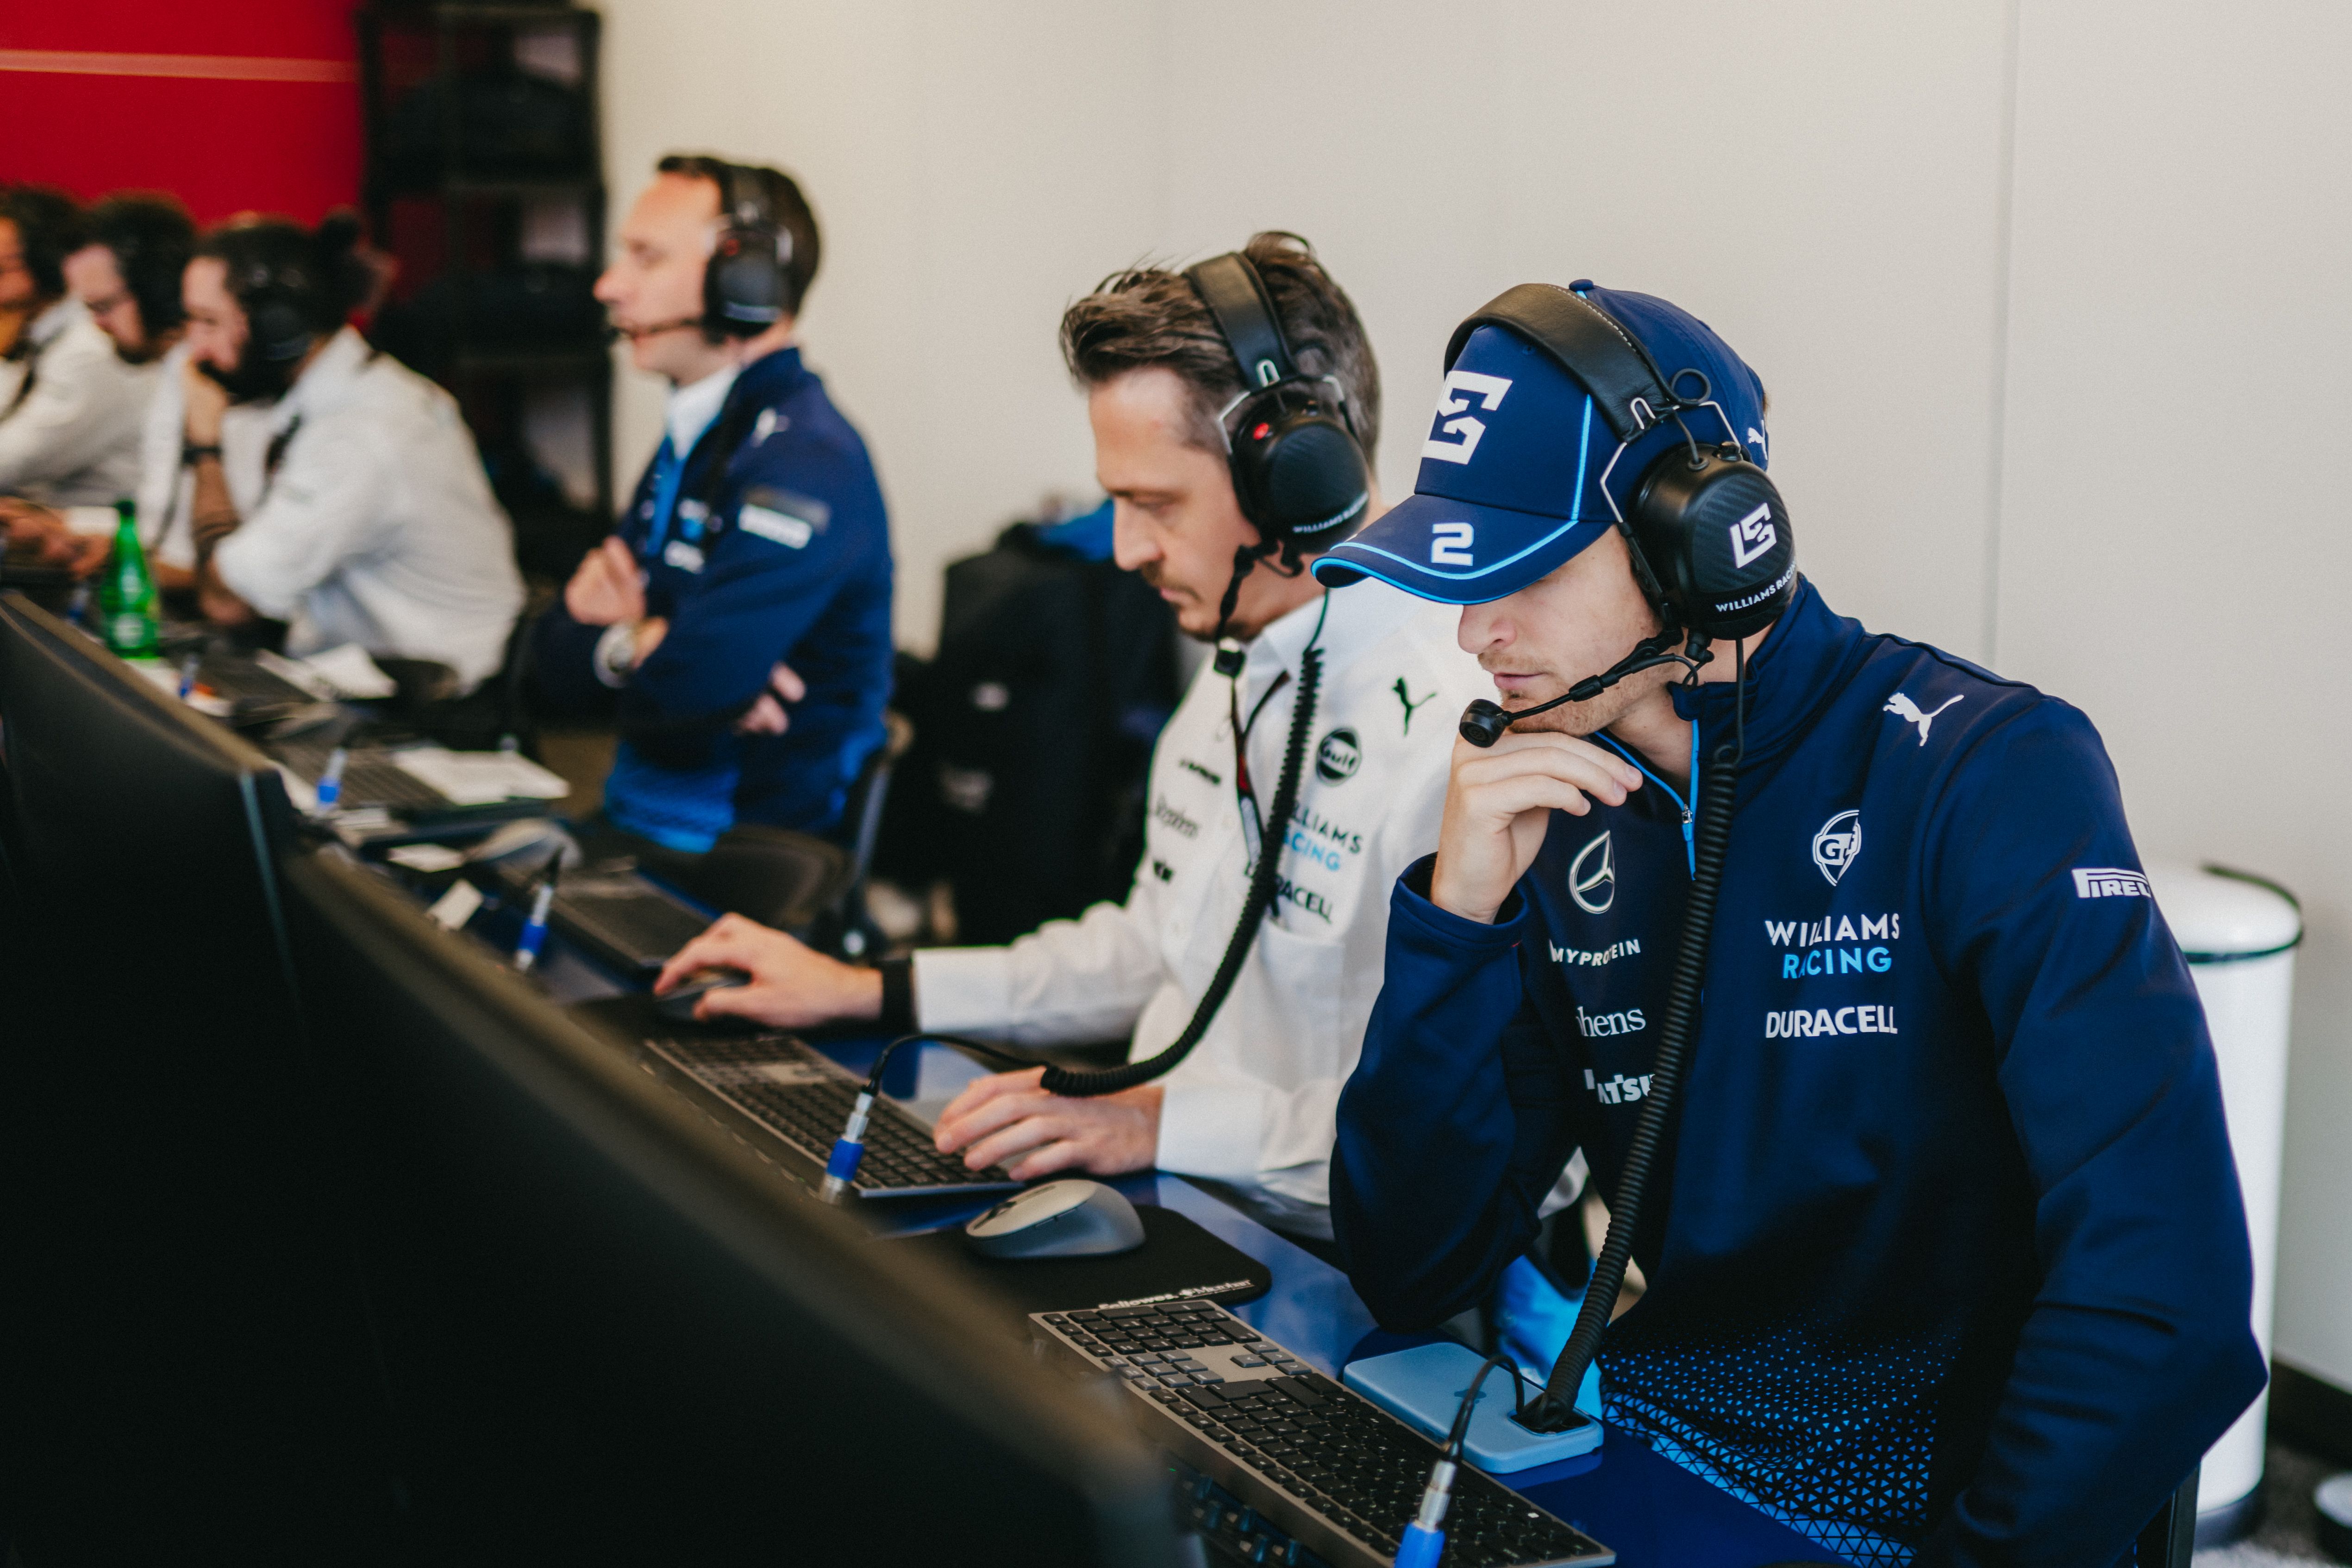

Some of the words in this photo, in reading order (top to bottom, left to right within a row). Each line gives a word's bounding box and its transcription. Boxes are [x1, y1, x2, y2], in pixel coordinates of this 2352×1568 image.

[1431, 522, 1475, 567] 2
[1715, 584, 1776, 612] WILLIAMS
[1776, 561, 1796, 590] RACIN
[2071, 868, 2152, 899] PIREL
[1764, 913, 1900, 948] WILLIAMS
[1576, 1006, 1646, 1037] hens
[1765, 1005, 1898, 1038] DURACELL
